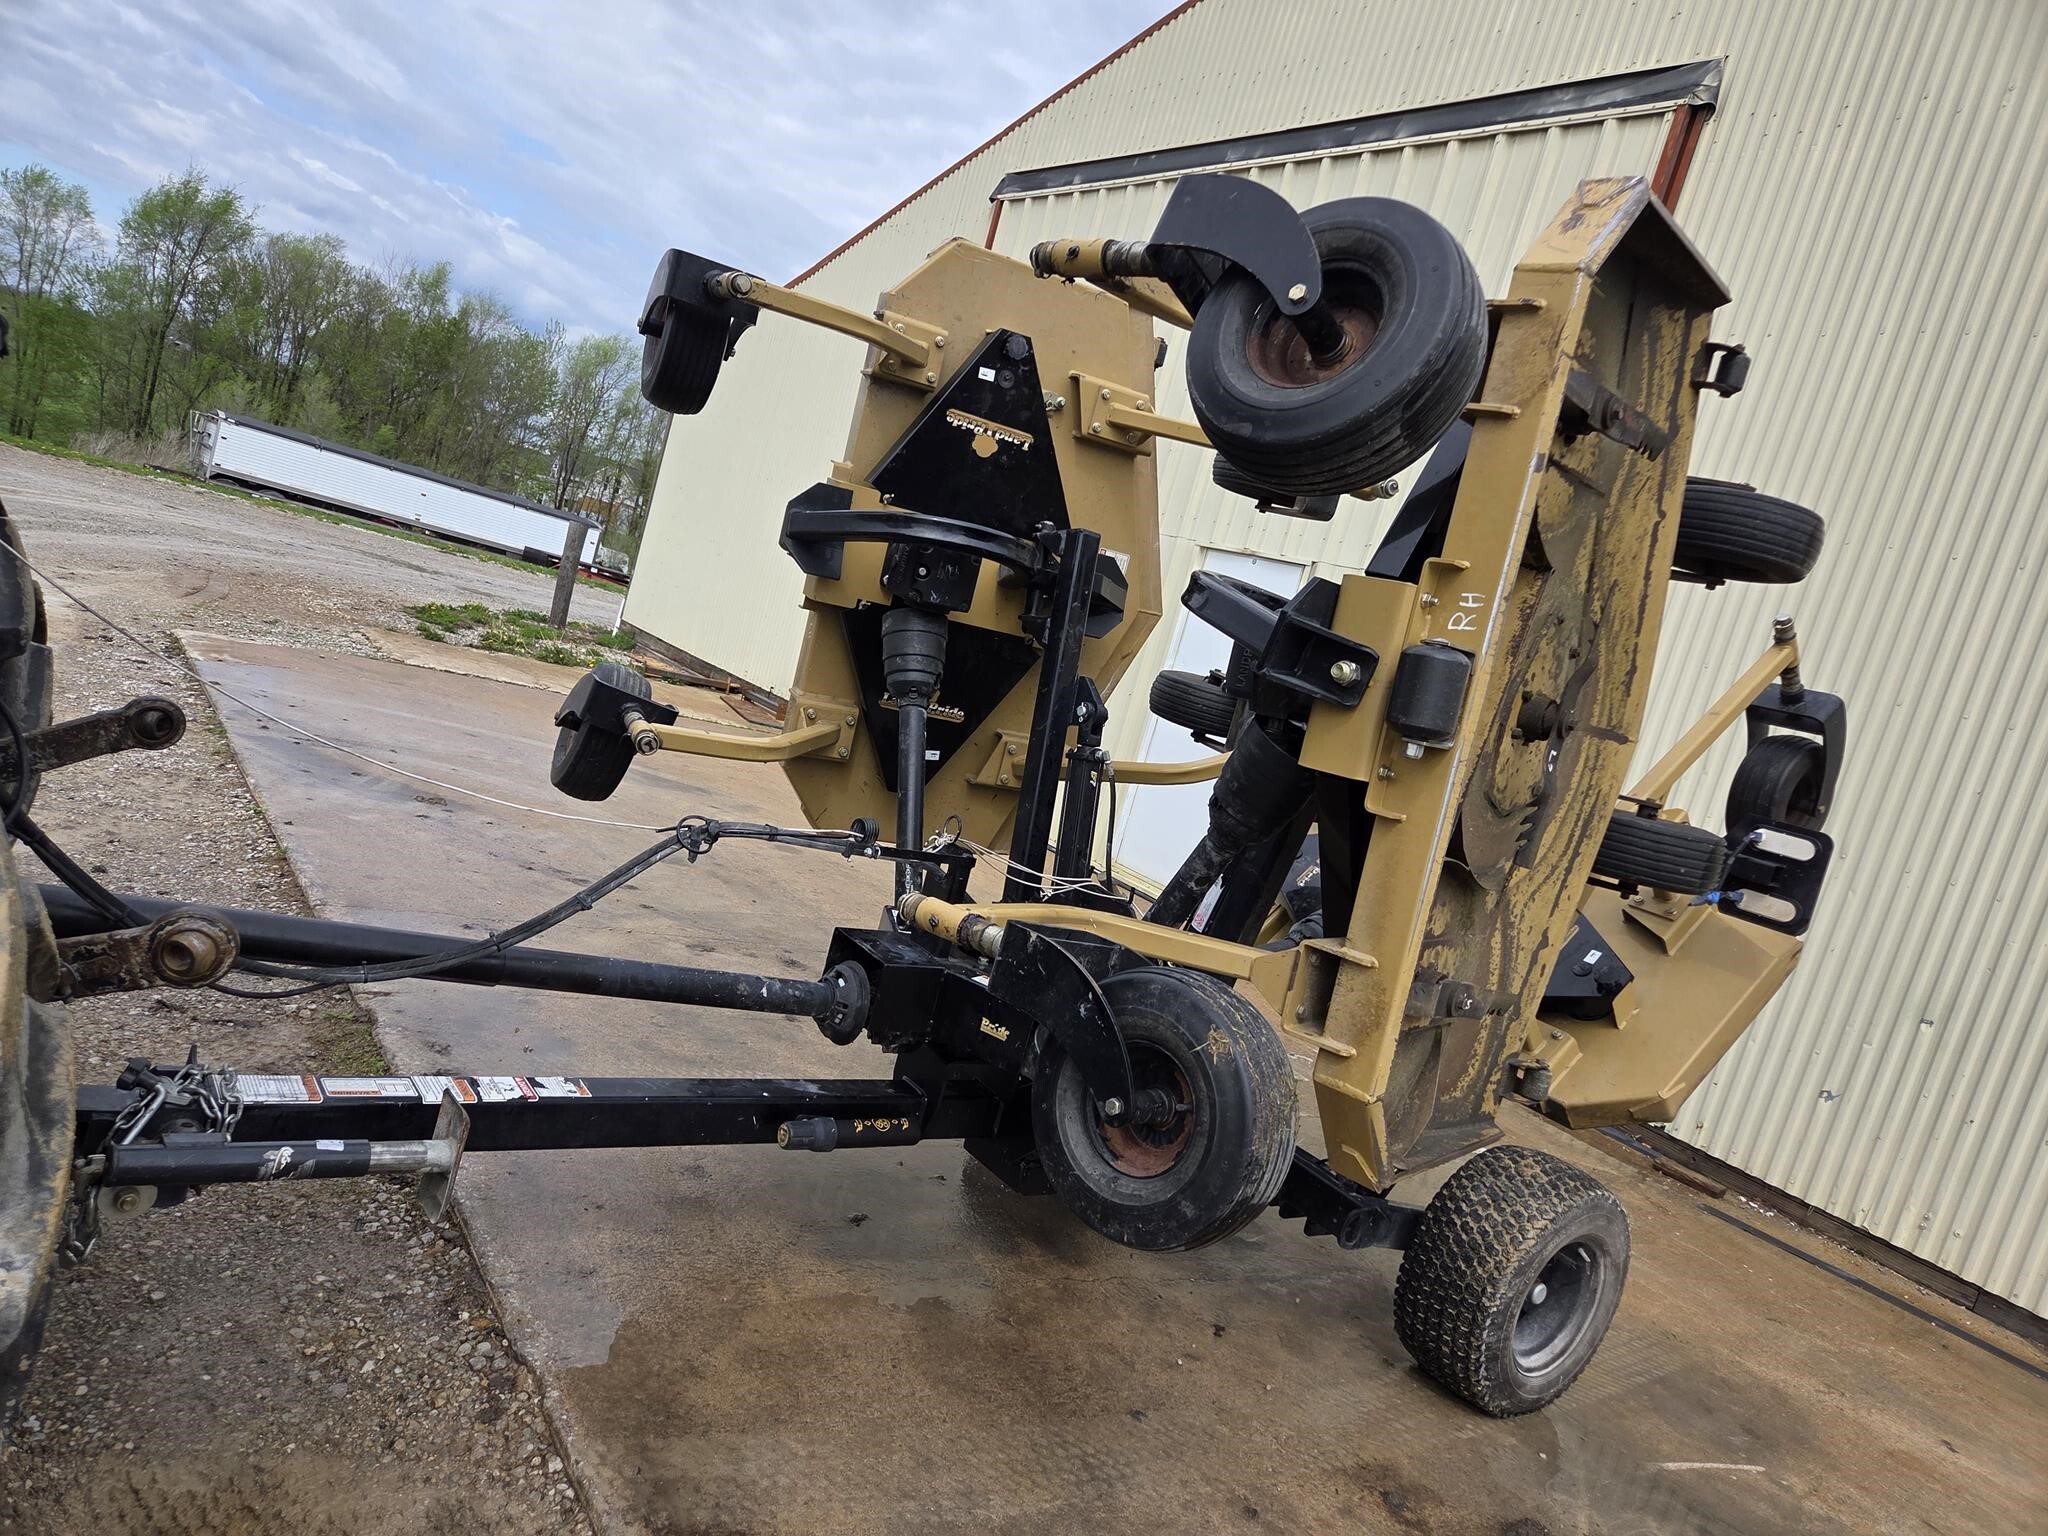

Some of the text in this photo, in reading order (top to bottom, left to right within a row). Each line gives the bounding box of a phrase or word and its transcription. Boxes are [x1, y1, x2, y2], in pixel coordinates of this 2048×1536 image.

[945, 412, 1031, 452] Land Pride
[1447, 592, 1486, 631] RH
